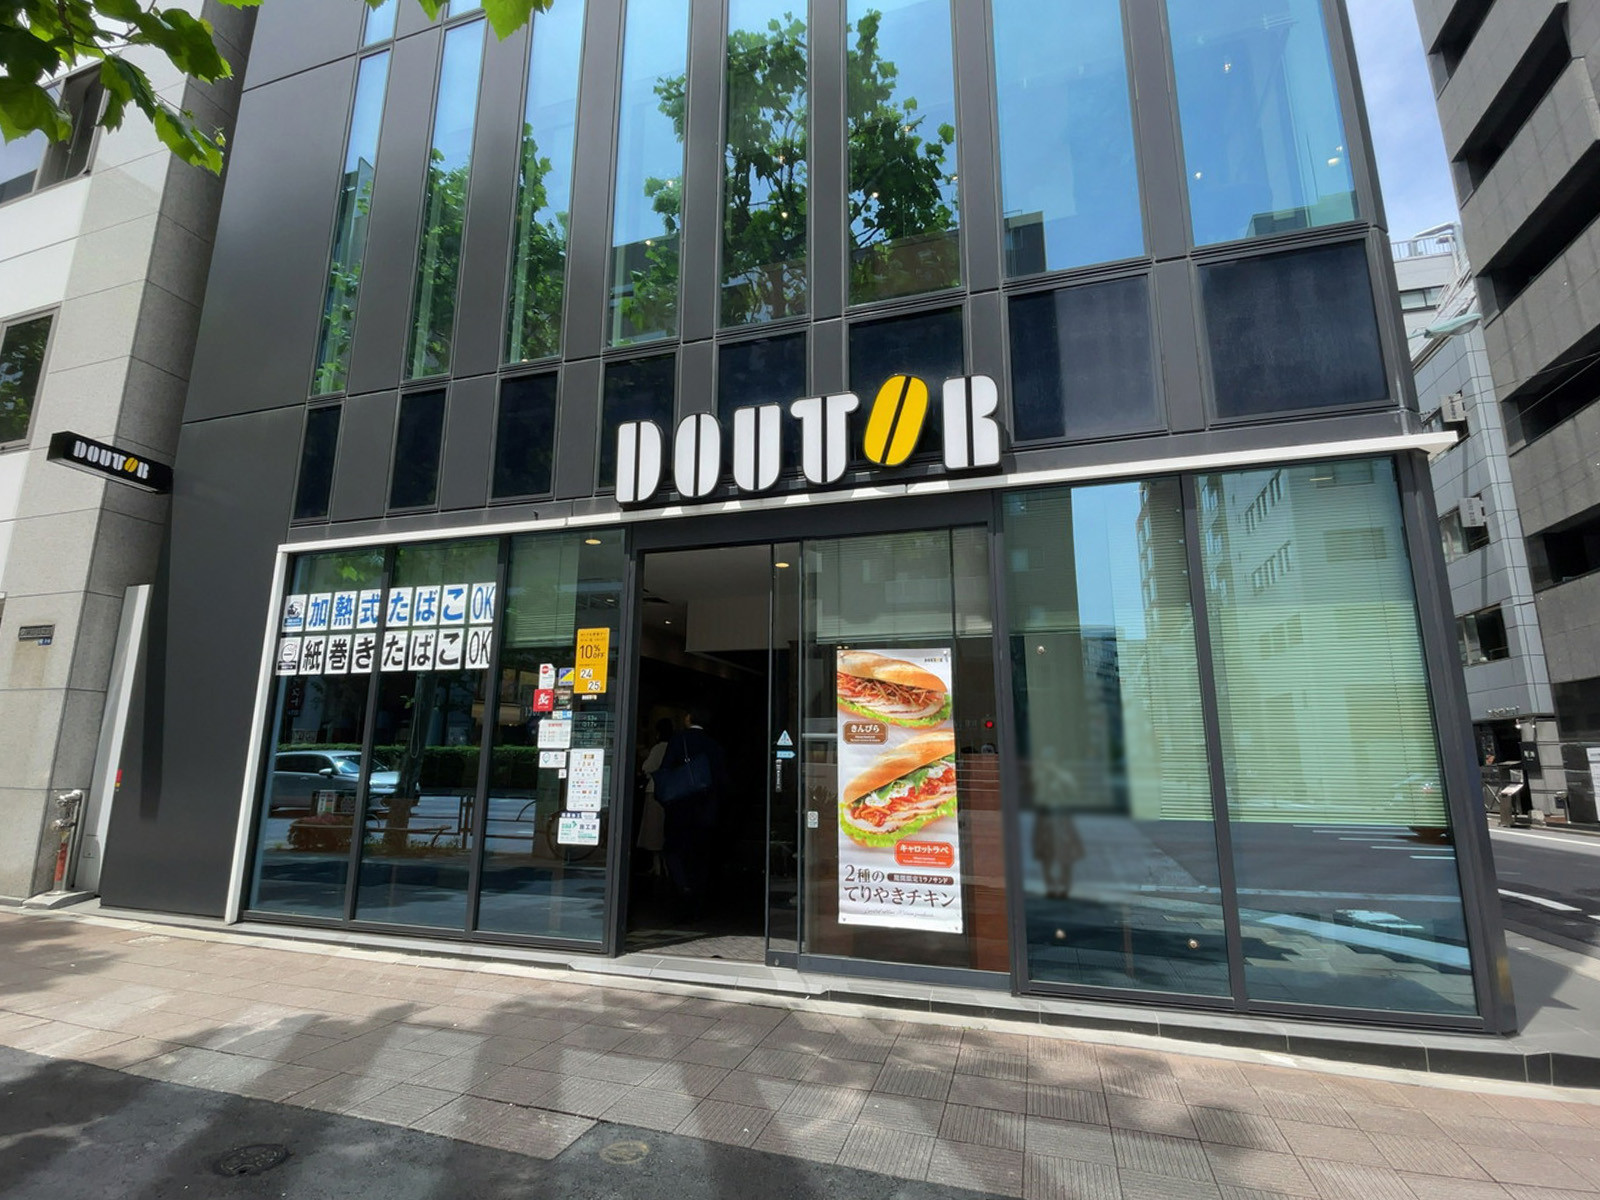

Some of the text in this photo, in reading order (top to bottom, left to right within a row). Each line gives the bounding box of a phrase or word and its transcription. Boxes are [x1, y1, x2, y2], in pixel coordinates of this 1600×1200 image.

[615, 373, 1001, 503] DOUTOR
[73, 440, 149, 479] DOUTOR
[580, 669, 592, 679] 24
[588, 680, 600, 691] 25
[850, 724, 880, 734] きんぴら
[844, 864, 885, 883] 2種の
[843, 885, 956, 908] てりやきチキン
